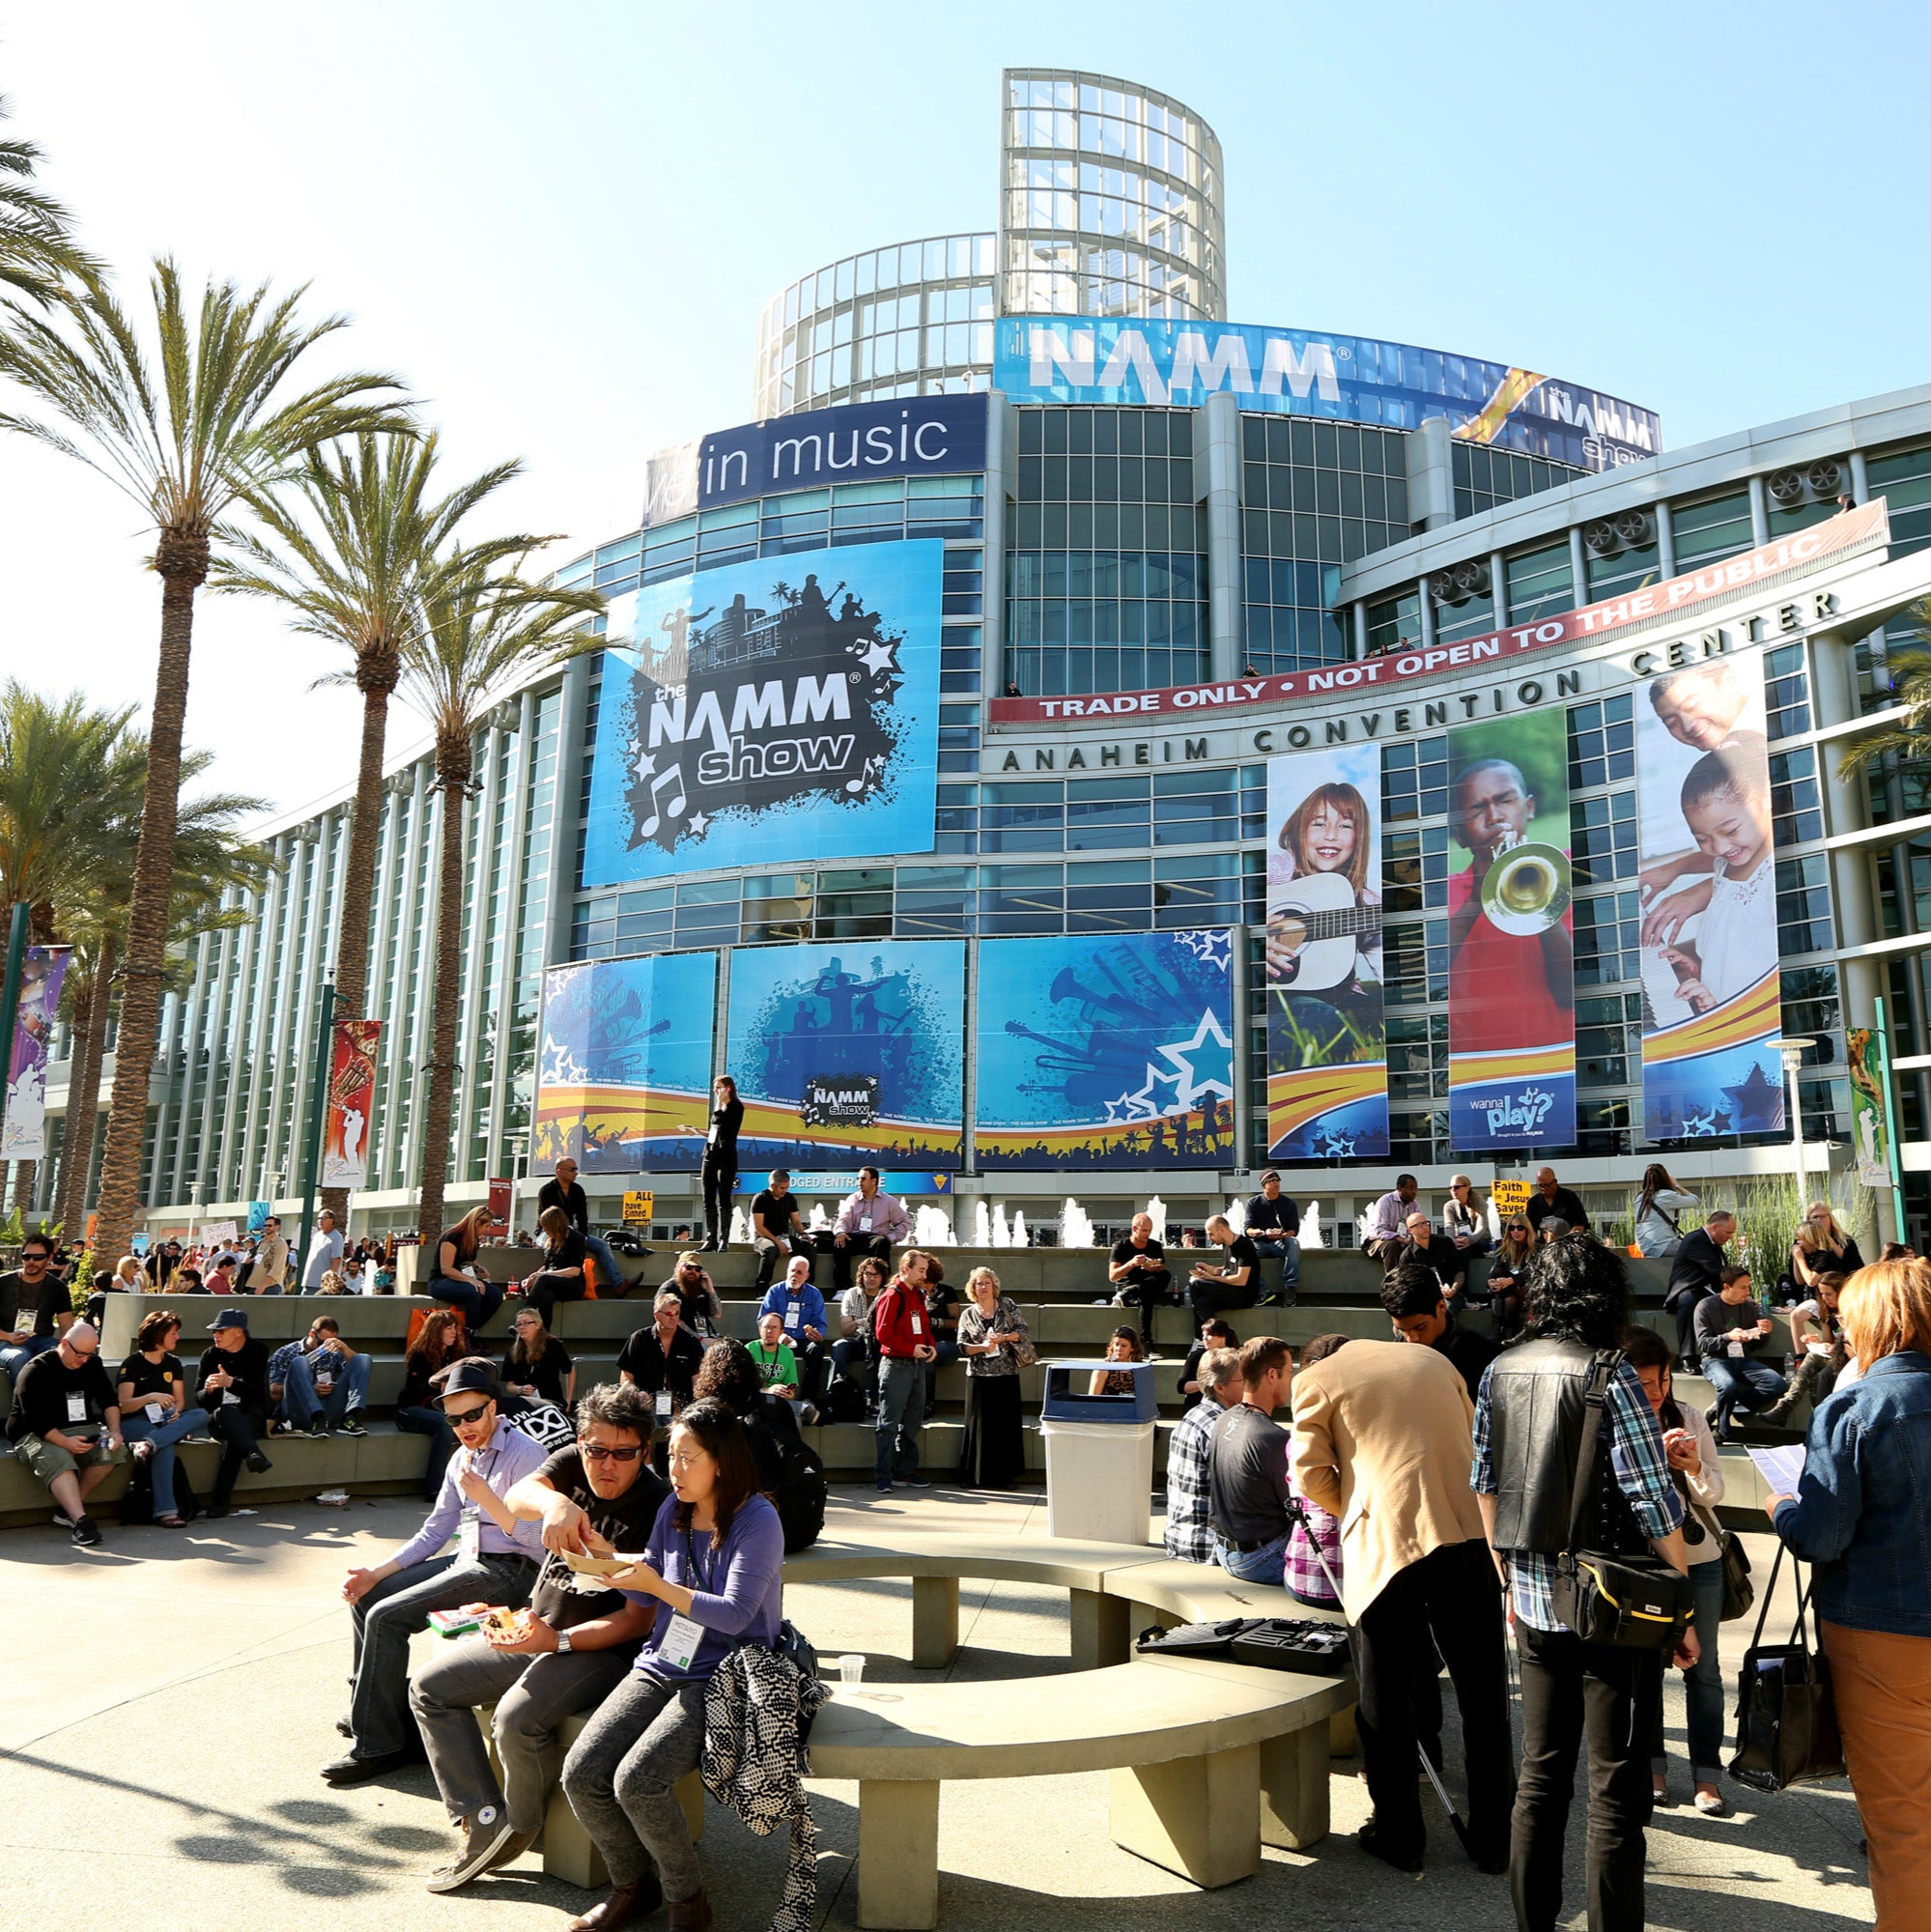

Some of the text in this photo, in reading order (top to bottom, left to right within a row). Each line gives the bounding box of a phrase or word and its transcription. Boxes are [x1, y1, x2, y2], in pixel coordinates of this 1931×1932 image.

[1029, 329, 1342, 404] NAMM
[1548, 386, 1571, 400] the
[1548, 393, 1652, 451] NAMM
[706, 444, 748, 495] in
[773, 410, 949, 479] music
[1039, 533, 1823, 718] TRADE ONLY NOT OPEN TO THE PUBLIC
[1003, 591, 1835, 772] ANAHEIM CONVENTION CENTER
[655, 683, 687, 702] the
[648, 672, 851, 752] NAMM
[697, 734, 856, 784] show
[813, 1090, 869, 1106] NAMM
[1470, 1098, 1504, 1110] wanna
[829, 1105, 869, 1115] show
[1487, 1093, 1553, 1136] play?
[789, 1176, 886, 1188] DGED ENTRAE
[1493, 1180, 1523, 1192] Faith
[636, 1191, 652, 1201] ALL
[1504, 1192, 1530, 1204] Jesus
[1495, 1203, 1525, 1213] Saves
[509, 1410, 532, 1426] UVI
